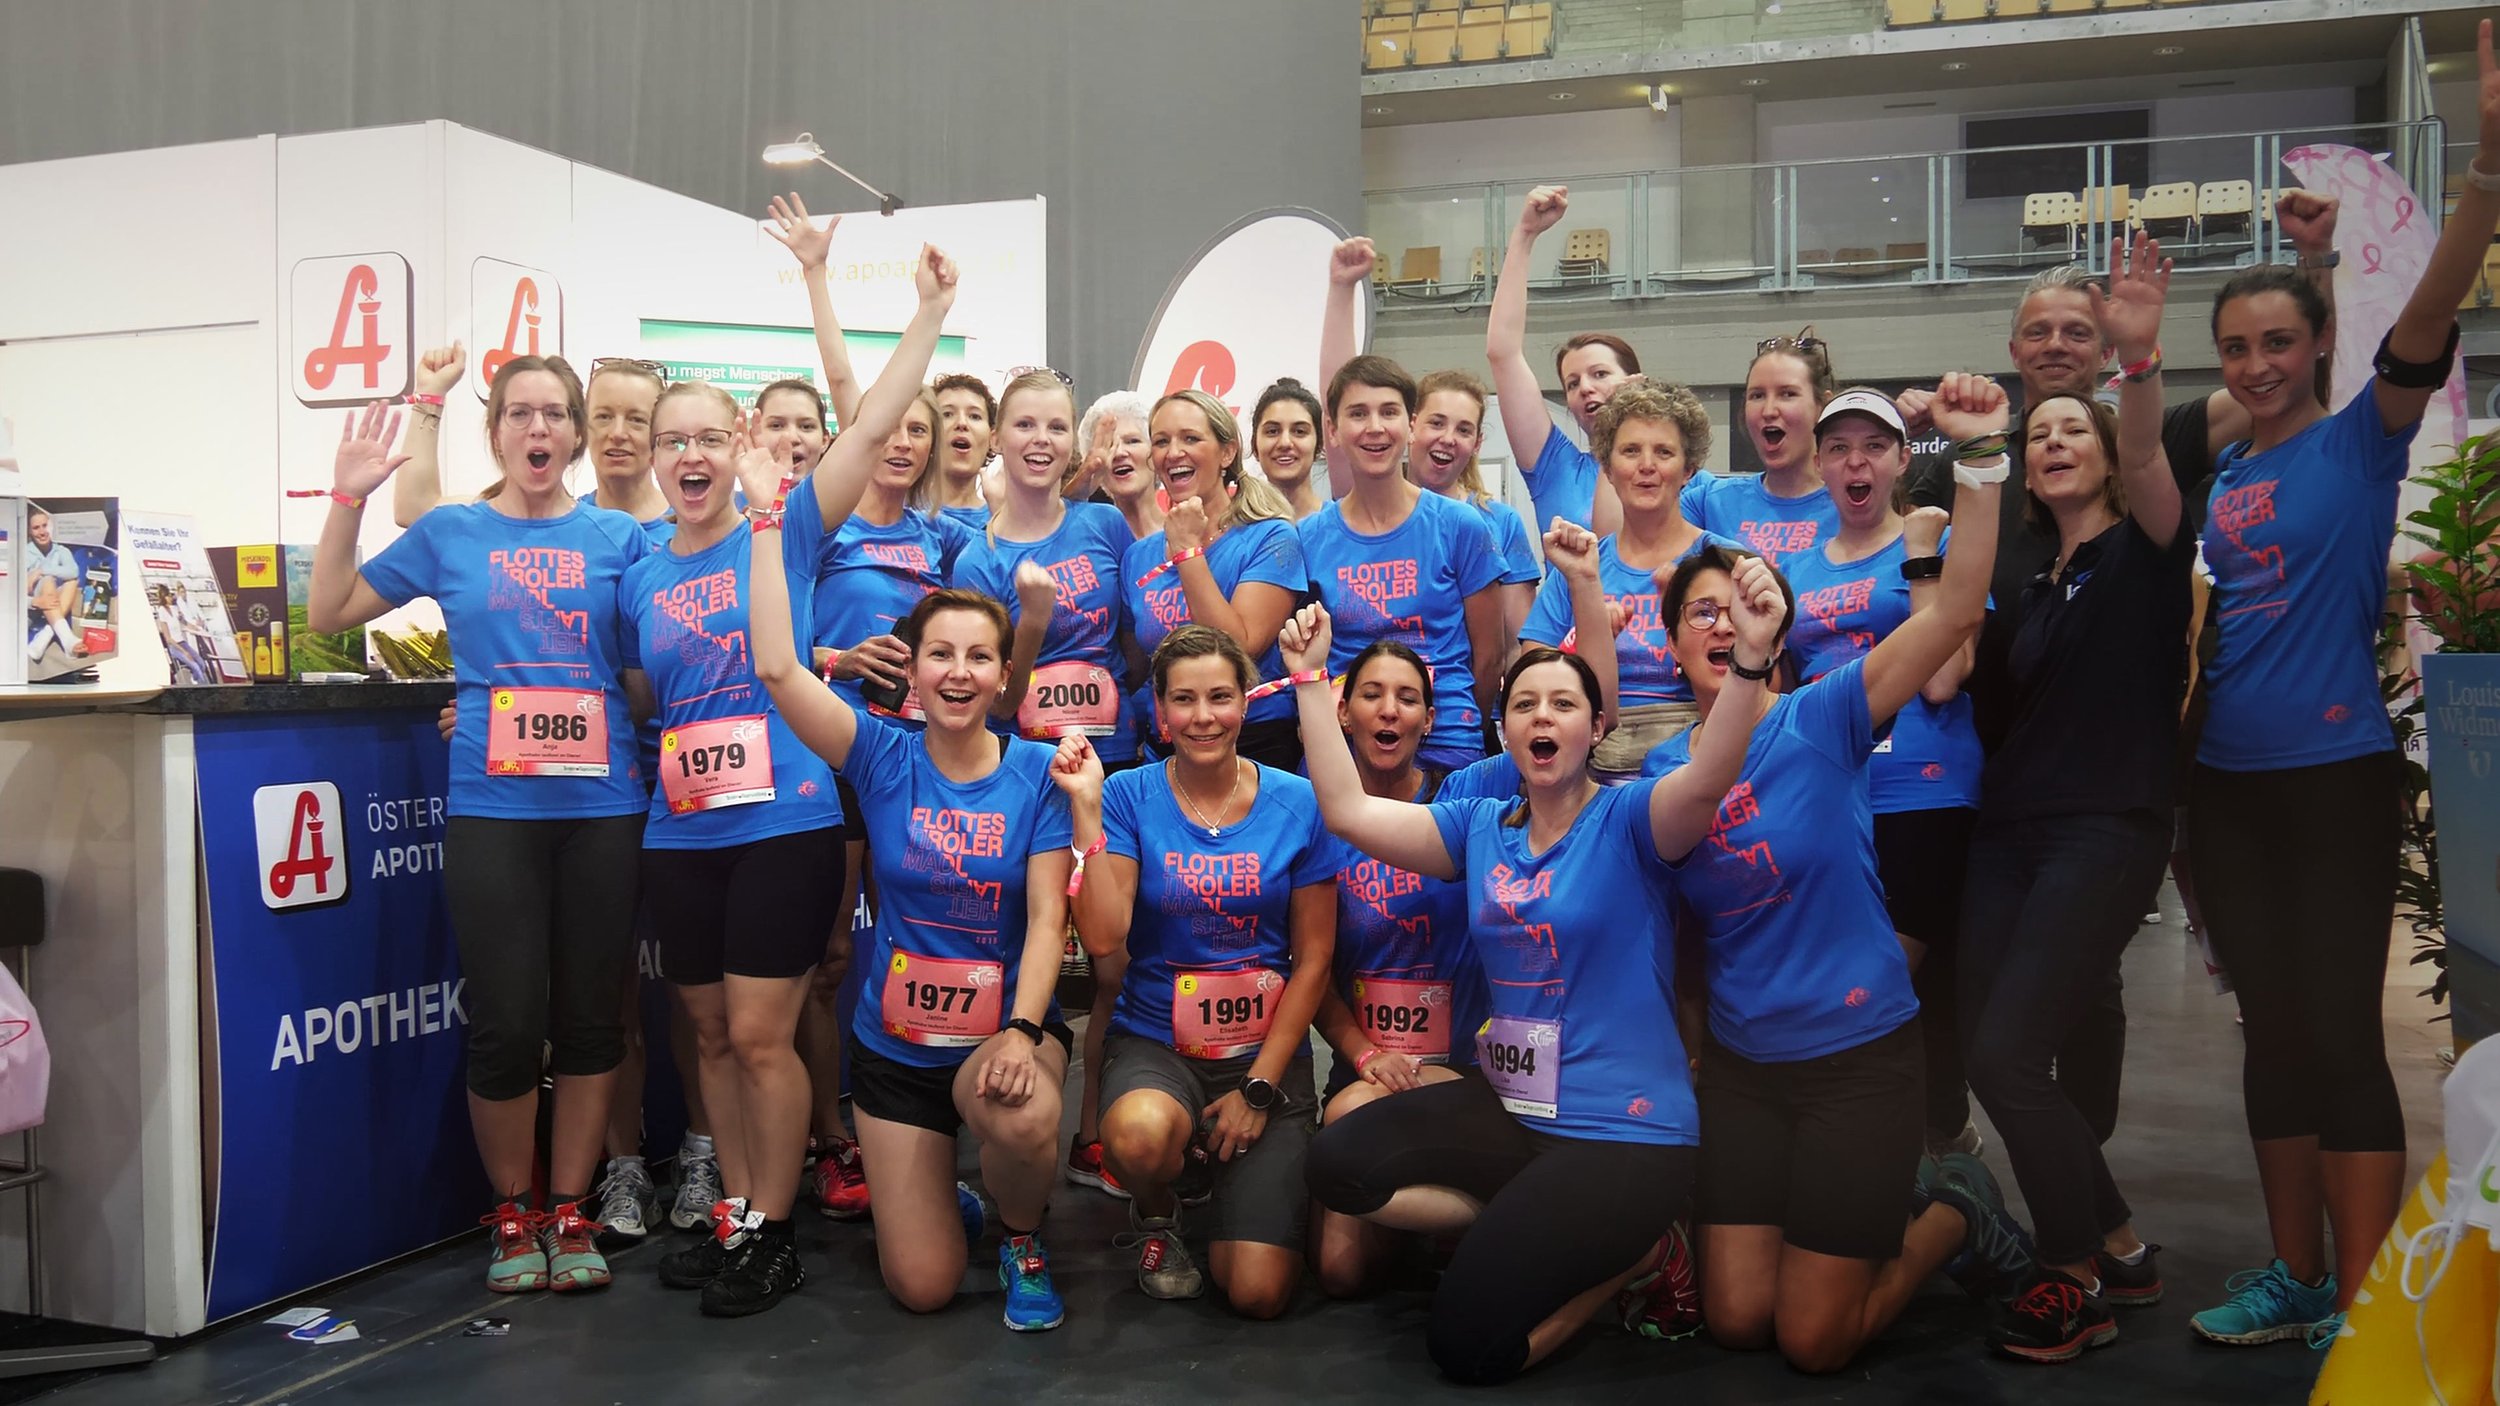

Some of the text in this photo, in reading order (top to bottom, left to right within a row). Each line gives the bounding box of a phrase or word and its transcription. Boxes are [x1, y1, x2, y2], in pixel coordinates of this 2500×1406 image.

[680, 366, 726, 381] magst
[1906, 436, 1950, 455] arde
[1740, 520, 1818, 539] FLOTTES
[489, 547, 586, 569] FLOTTES
[862, 543, 926, 563] FLOTTES
[1337, 559, 1418, 584] FLOTTES
[653, 568, 738, 606] FLOTTES
[1799, 577, 1877, 603] FLOTTES
[500, 696, 508, 705] G
[1037, 683, 1101, 709] 2000
[513, 713, 588, 742] 1986
[677, 742, 747, 778] 1979
[912, 807, 1006, 835] FLOTTES
[1164, 851, 1261, 875] FLOTTES
[1345, 872, 1423, 903] ROLER
[896, 958, 903, 968] A
[904, 980, 978, 1014] 1977
[1184, 980, 1191, 989] E
[926, 1013, 948, 1022] Janine
[1198, 993, 1265, 1025] 1991
[1363, 1003, 1430, 1033] 1992
[270, 977, 470, 1072] APOTHEK
[1381, 1034, 1405, 1042] Sabrina
[1486, 1041, 1536, 1077] 1994
